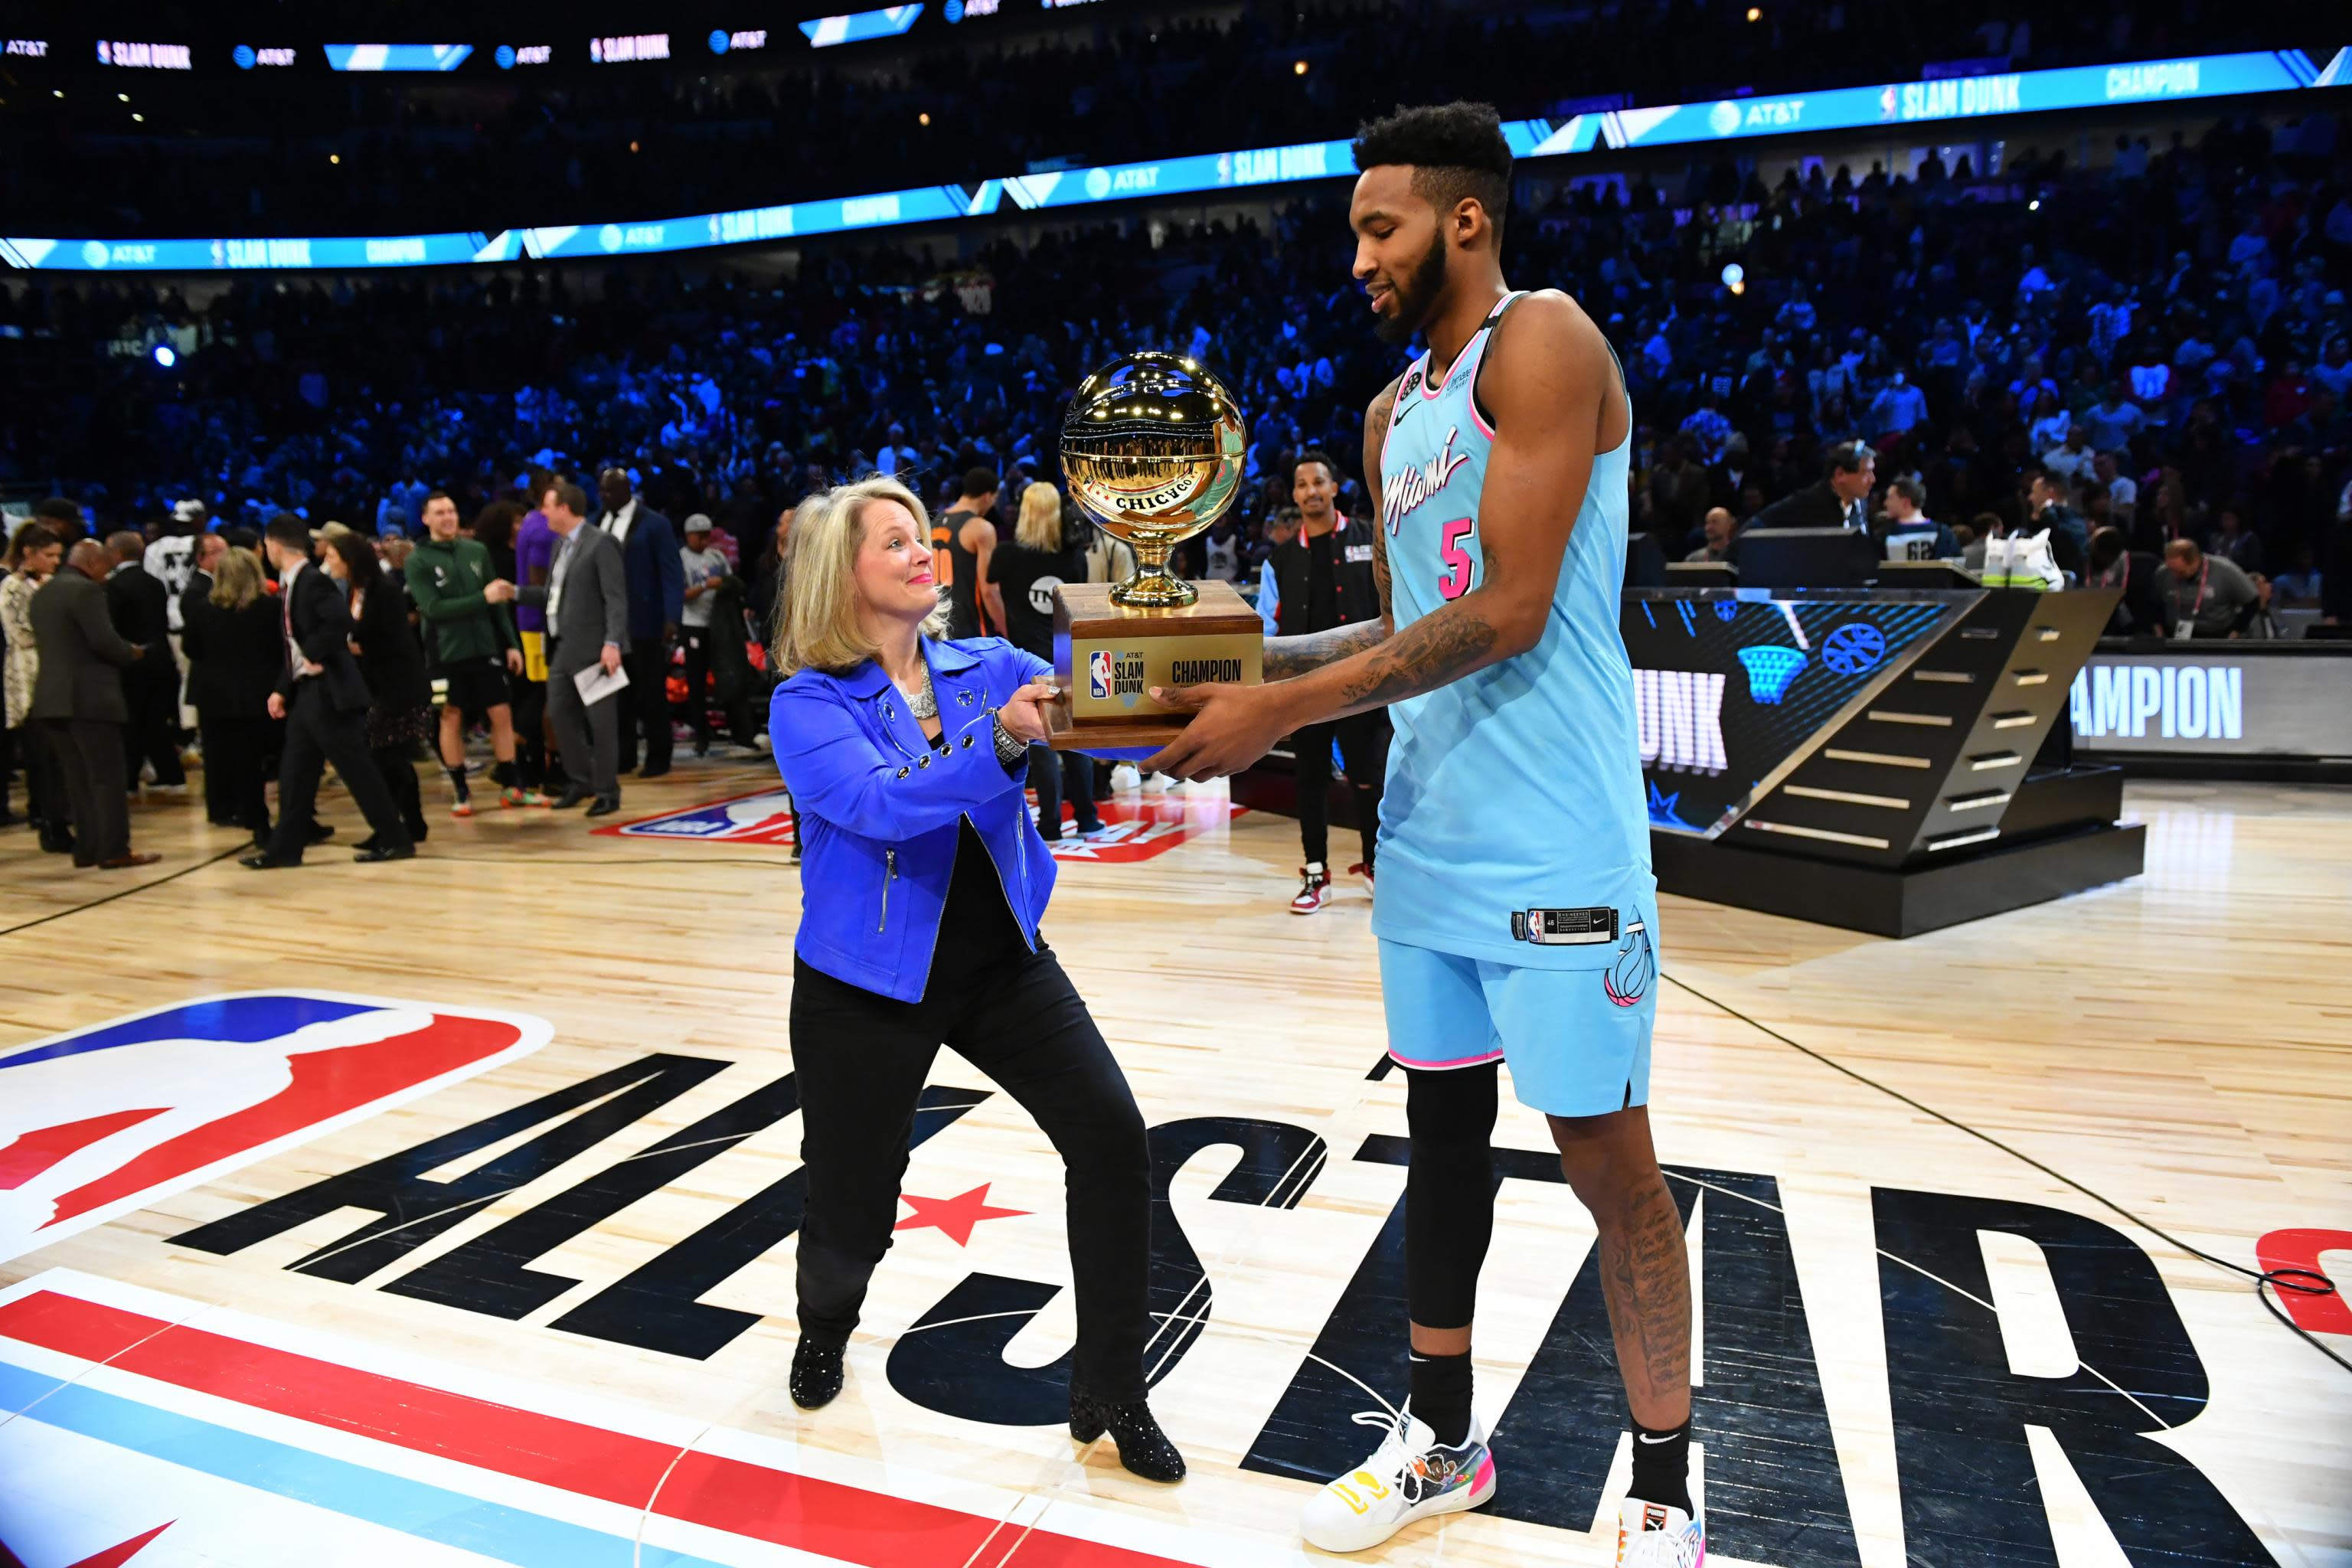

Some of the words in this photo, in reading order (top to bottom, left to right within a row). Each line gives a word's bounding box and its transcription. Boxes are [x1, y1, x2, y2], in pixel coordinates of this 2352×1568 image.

[6, 40, 48, 57] AT&T
[113, 41, 152, 67] SLAM
[152, 44, 191, 70] DUNK
[256, 48, 296, 67] AT&T
[1903, 80, 1957, 119] SLAM
[1962, 74, 2021, 113] DUNK
[1746, 100, 1805, 126] AT&T
[1234, 149, 1278, 185] SLAM
[1280, 143, 1327, 181] DUNK
[1114, 167, 1160, 191] AT&T
[112, 245, 156, 264] AT&T
[227, 240, 268, 268] SLAM
[1383, 425, 1469, 536] Miami
[1439, 518, 1475, 602] 5
[1115, 662, 1144, 680] SLAM
[1172, 659, 1241, 683] CHAMPION
[1115, 680, 1144, 695] DUNK
